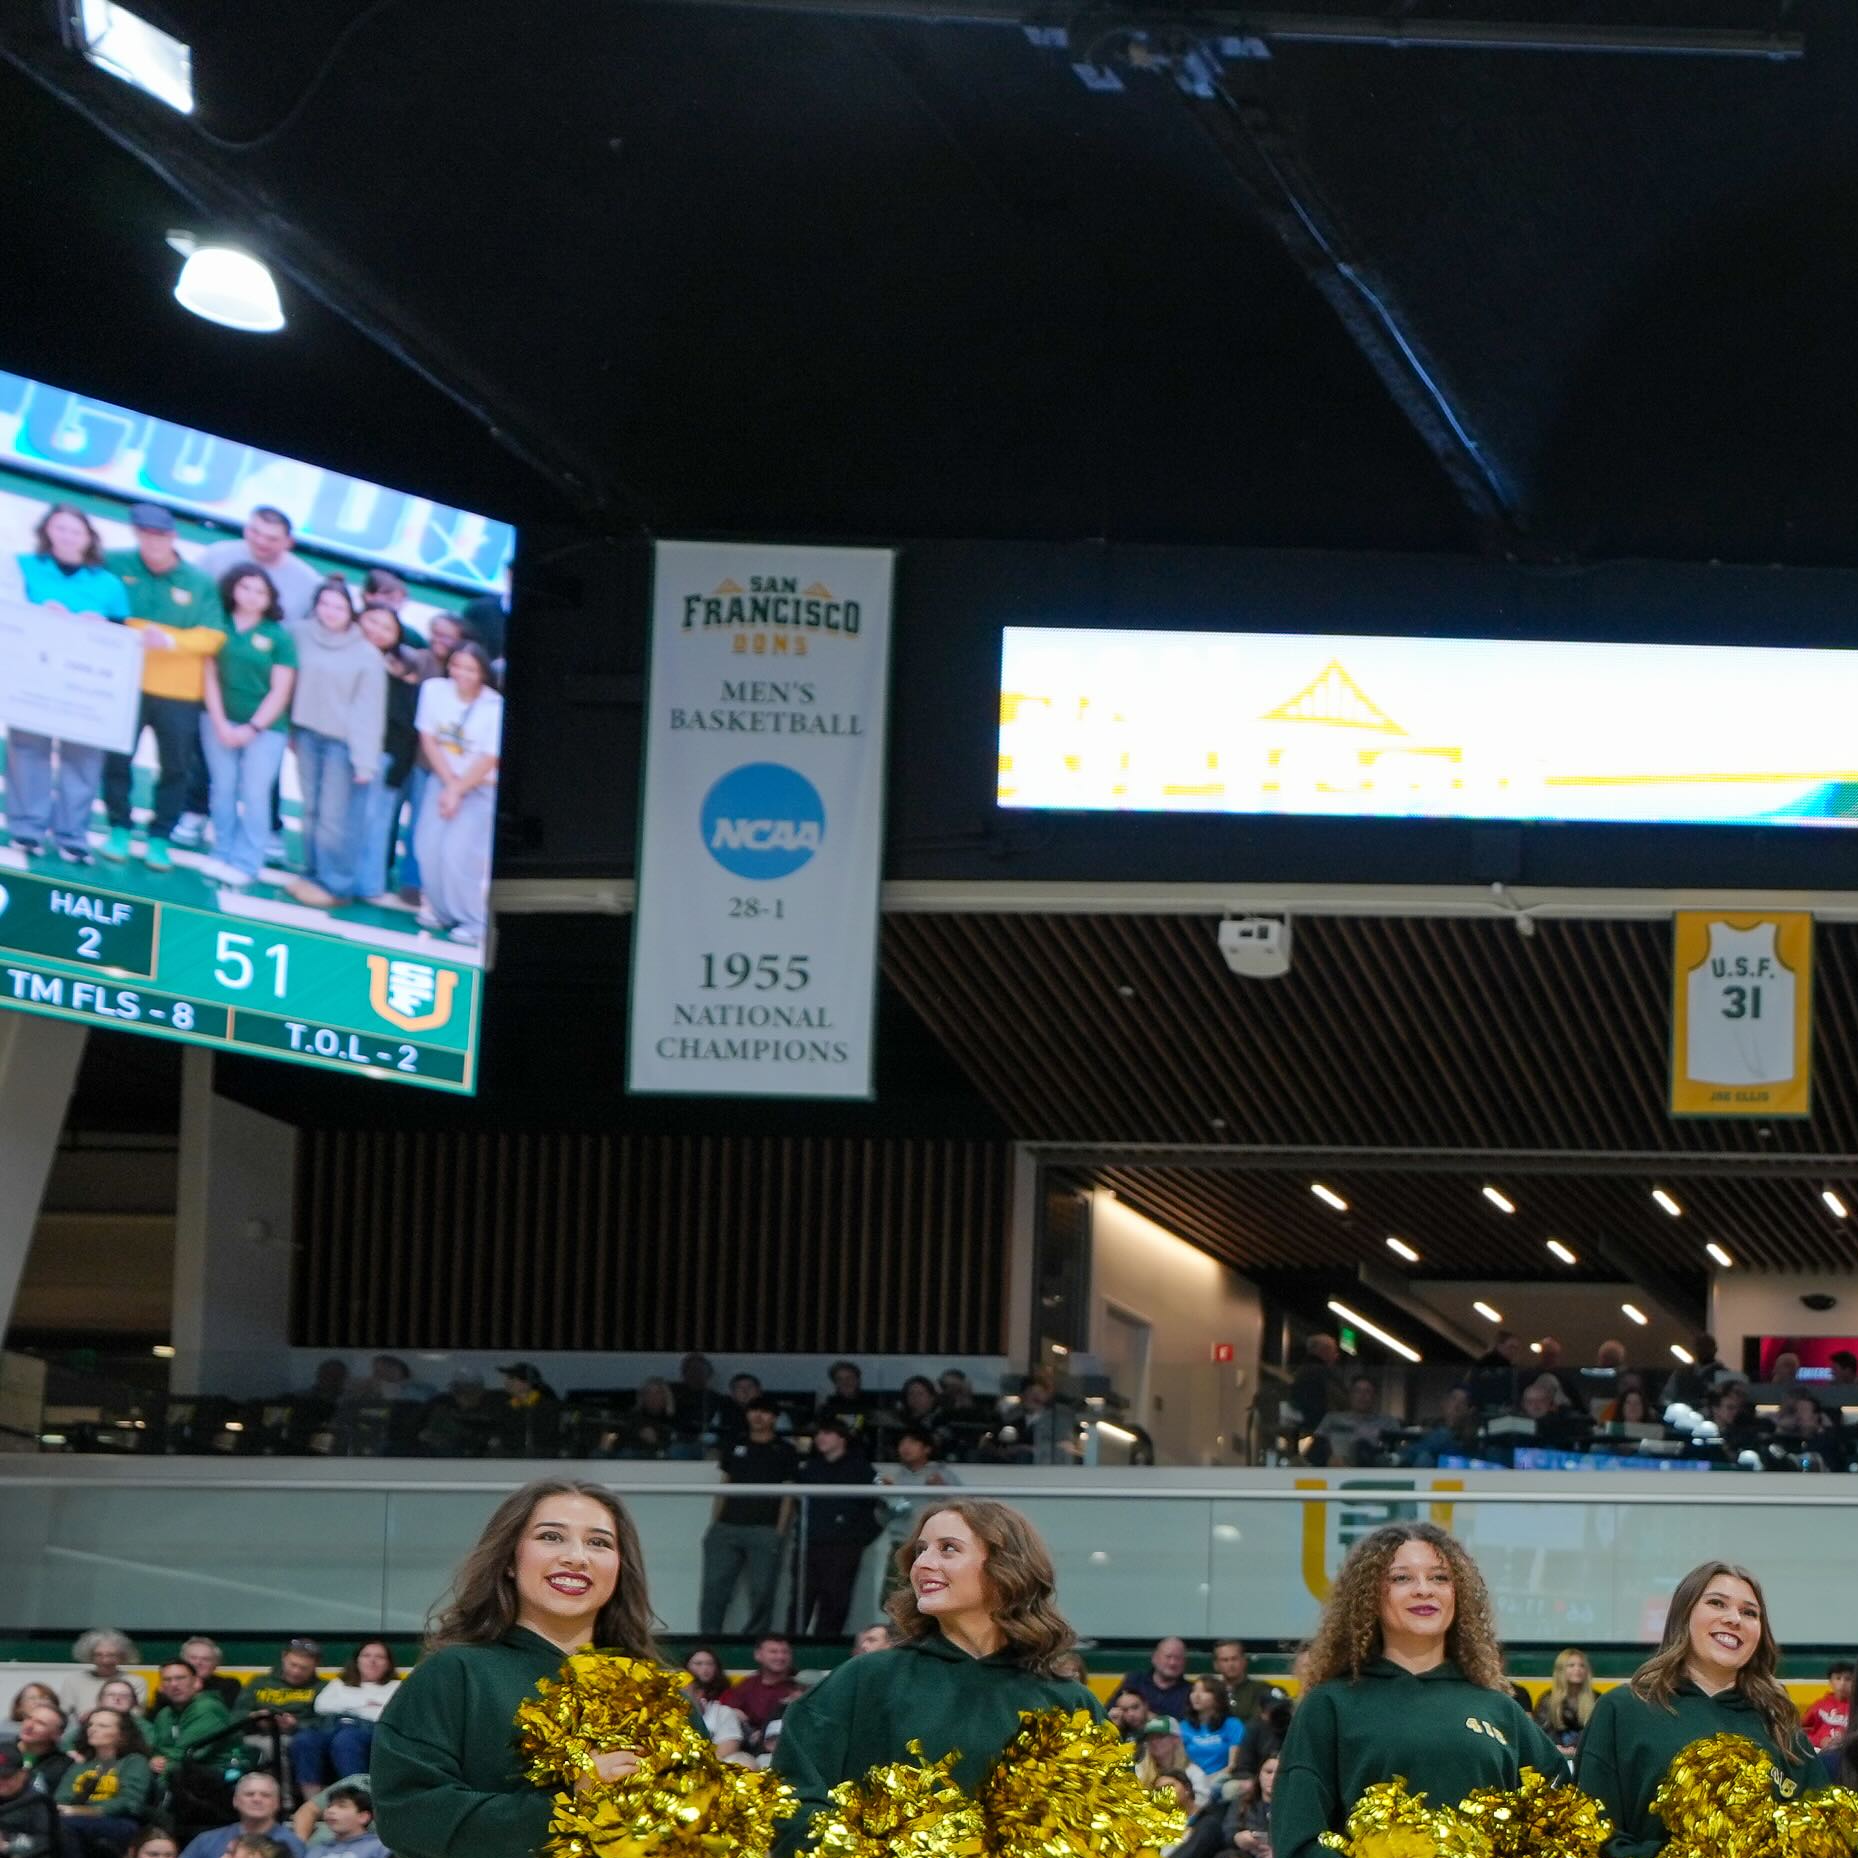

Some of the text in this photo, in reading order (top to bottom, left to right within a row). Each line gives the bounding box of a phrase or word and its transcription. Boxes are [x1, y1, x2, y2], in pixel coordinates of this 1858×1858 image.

[749, 576, 798, 593] SAN
[682, 594, 860, 634] FRANCISCO
[732, 633, 808, 655] DONS
[720, 680, 815, 705] MEN'S
[670, 708, 864, 736] BASKETBALL
[711, 817, 822, 851] NCAA
[51, 890, 133, 926] HALF
[728, 896, 784, 919] 28-1
[76, 926, 102, 960] 2
[214, 931, 289, 999] 51
[699, 952, 810, 992] 1955
[1711, 956, 1776, 980] U.S.F.
[8, 969, 63, 1006] TM
[72, 982, 141, 1020] FLS
[172, 1002, 195, 1031] 8
[1722, 985, 1763, 1020] 31
[673, 1003, 833, 1029] NATIONAL
[397, 1045, 418, 1073] 2
[656, 1036, 848, 1063] CHAMPIONS
